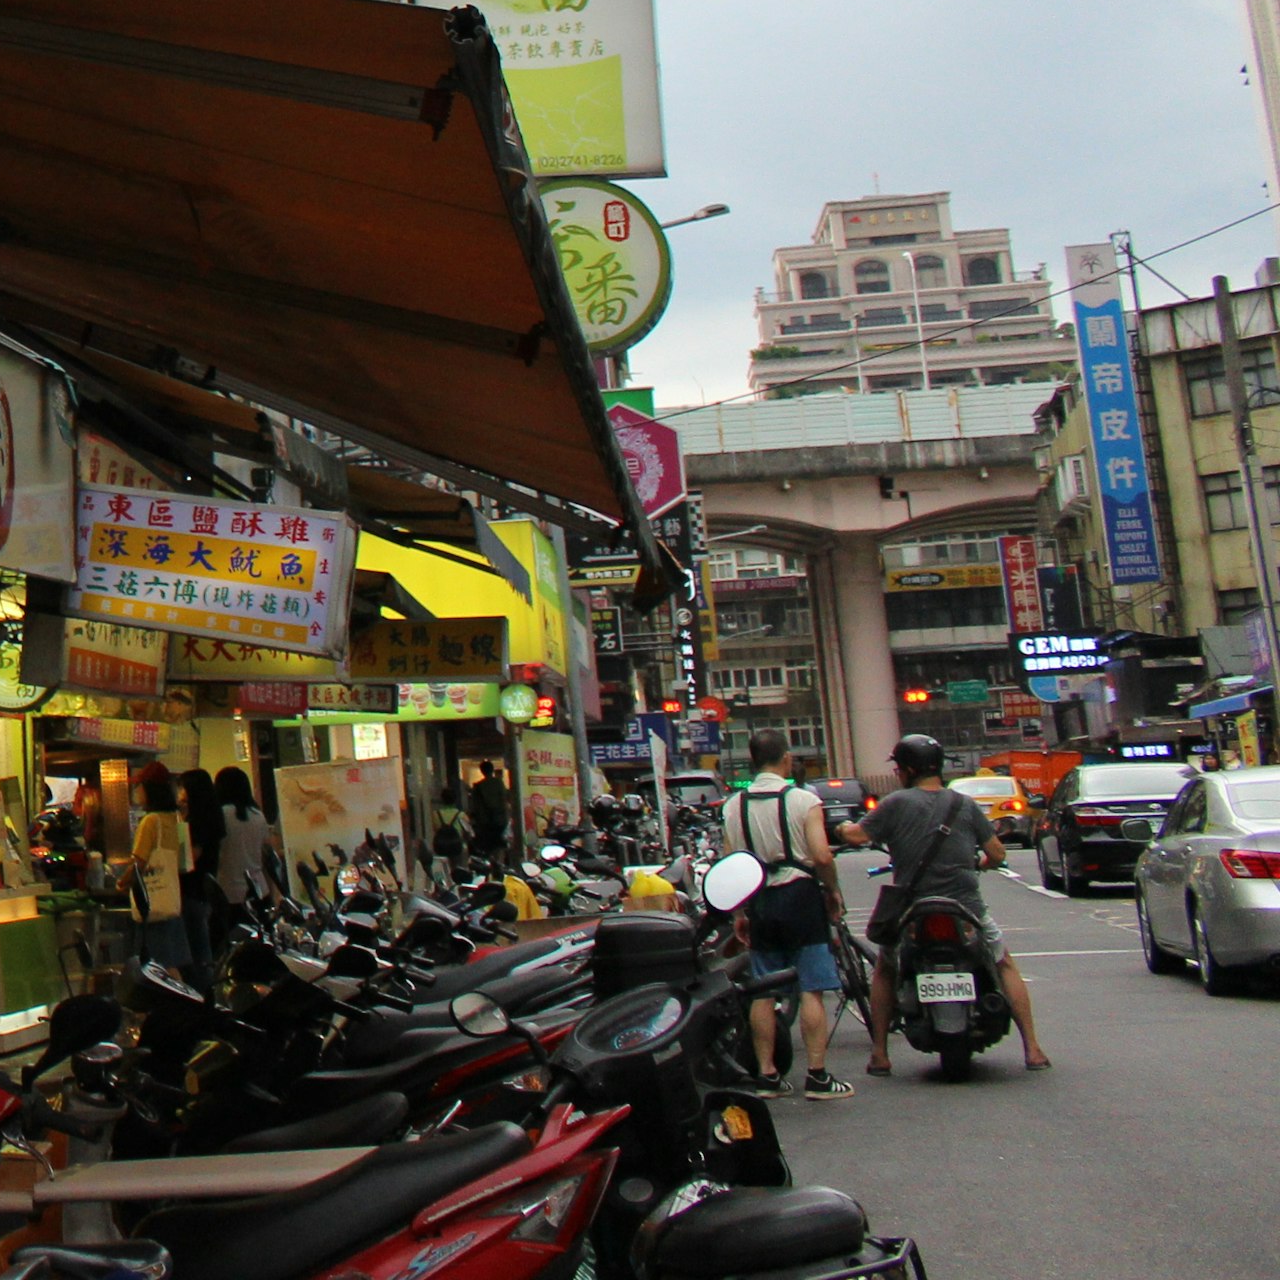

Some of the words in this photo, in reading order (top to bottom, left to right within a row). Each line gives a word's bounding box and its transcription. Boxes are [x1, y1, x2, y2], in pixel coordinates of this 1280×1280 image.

[499, 38, 606, 60] 茶飲專賣店
[104, 493, 311, 545] 東區鹽酥雞
[97, 527, 306, 586] 深海大魷魚
[1018, 635, 1070, 656] GEM
[919, 982, 973, 998] 999-HMQ
